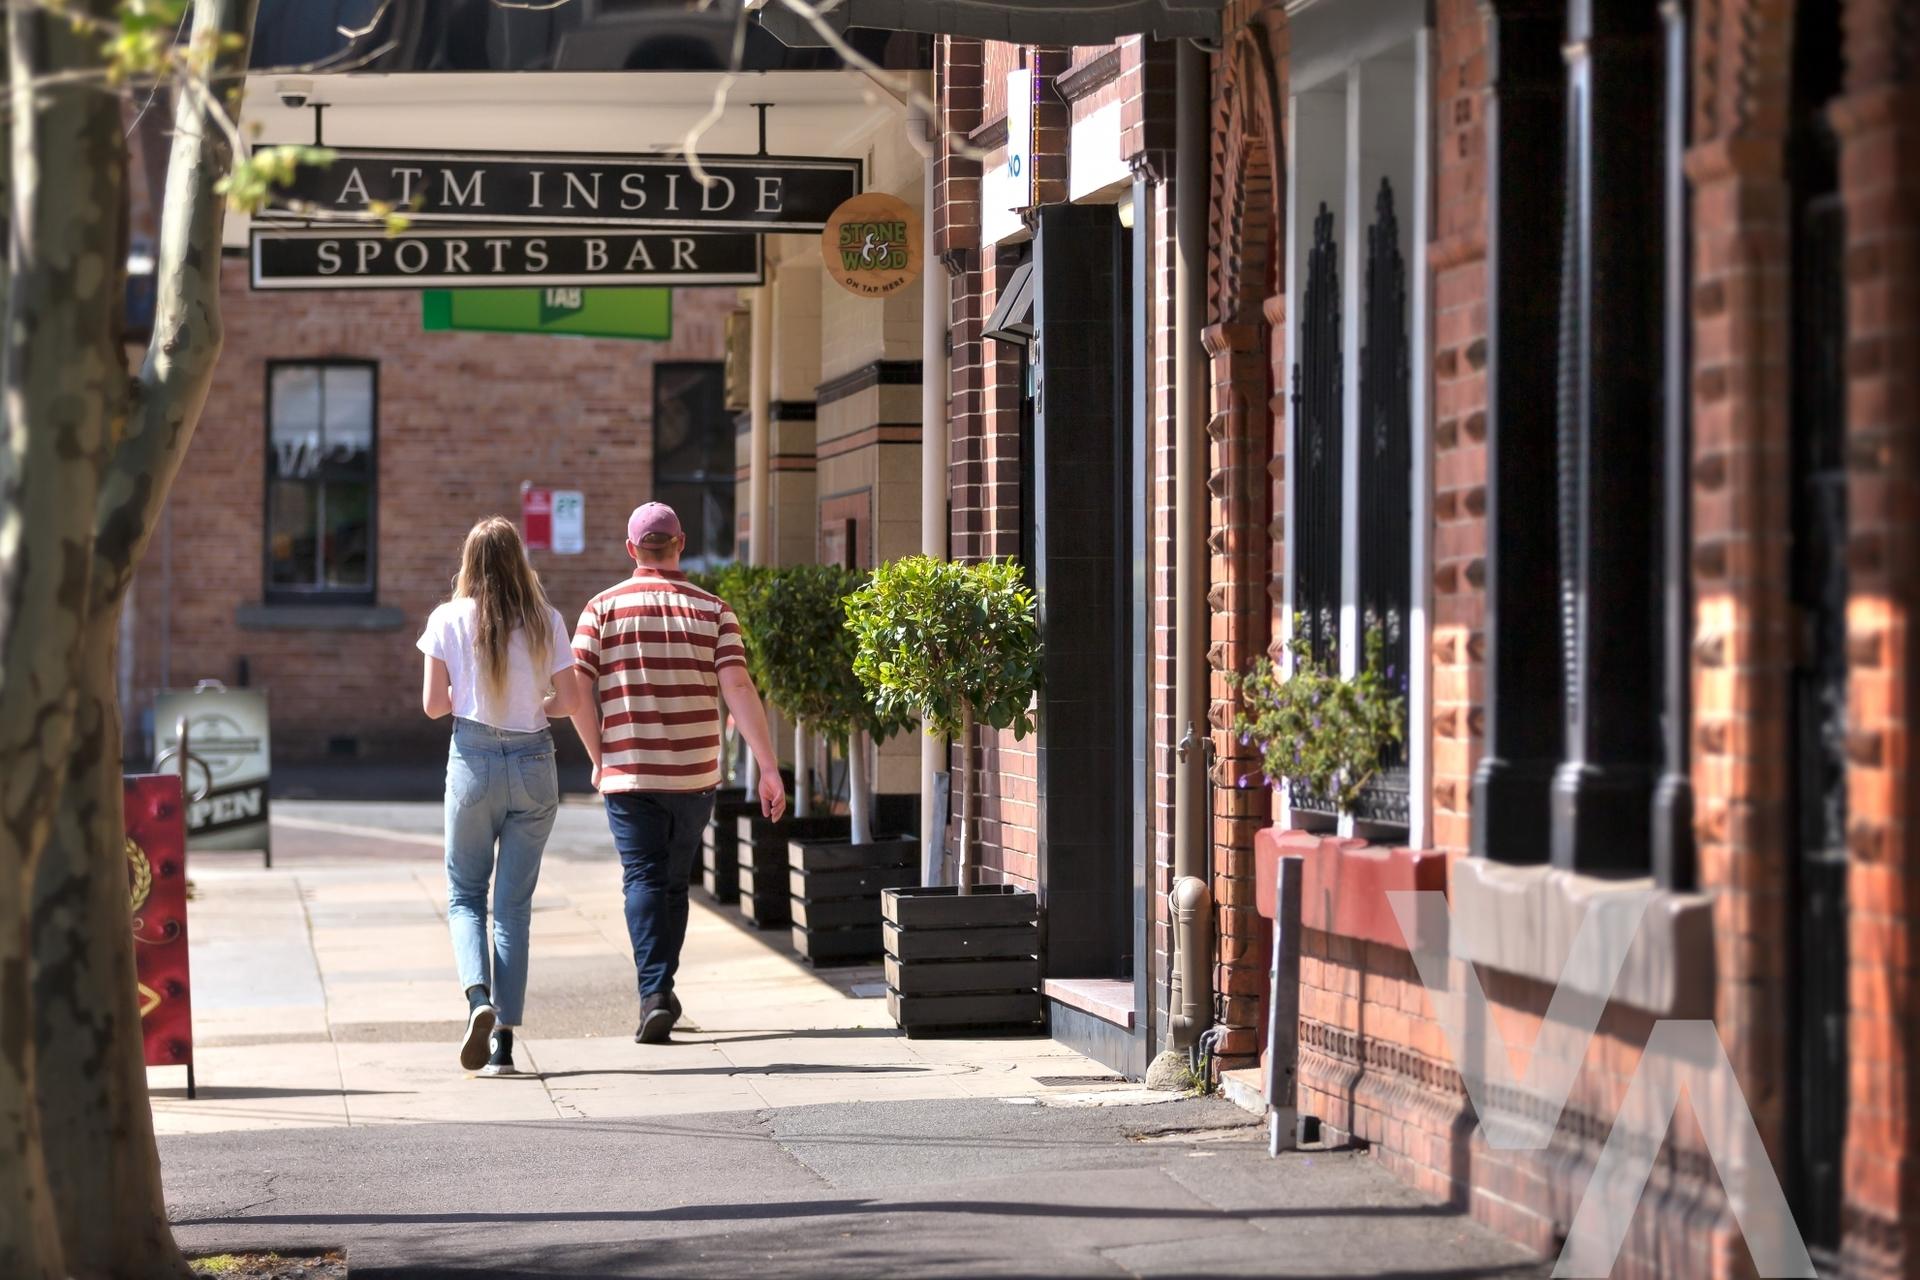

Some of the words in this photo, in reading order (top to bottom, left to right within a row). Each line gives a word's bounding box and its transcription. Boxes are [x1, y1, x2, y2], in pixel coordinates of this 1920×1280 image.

[336, 167, 486, 207] ATM
[528, 171, 783, 213] INSIDE
[839, 222, 907, 245] STONE
[862, 233, 888, 261] &
[317, 239, 549, 274] SPORTS
[584, 238, 698, 271] BAR
[841, 249, 907, 271] WOOD
[846, 278, 859, 289] ON
[862, 284, 879, 293] TAP
[882, 277, 905, 291] HERE
[188, 787, 263, 830] PEN
